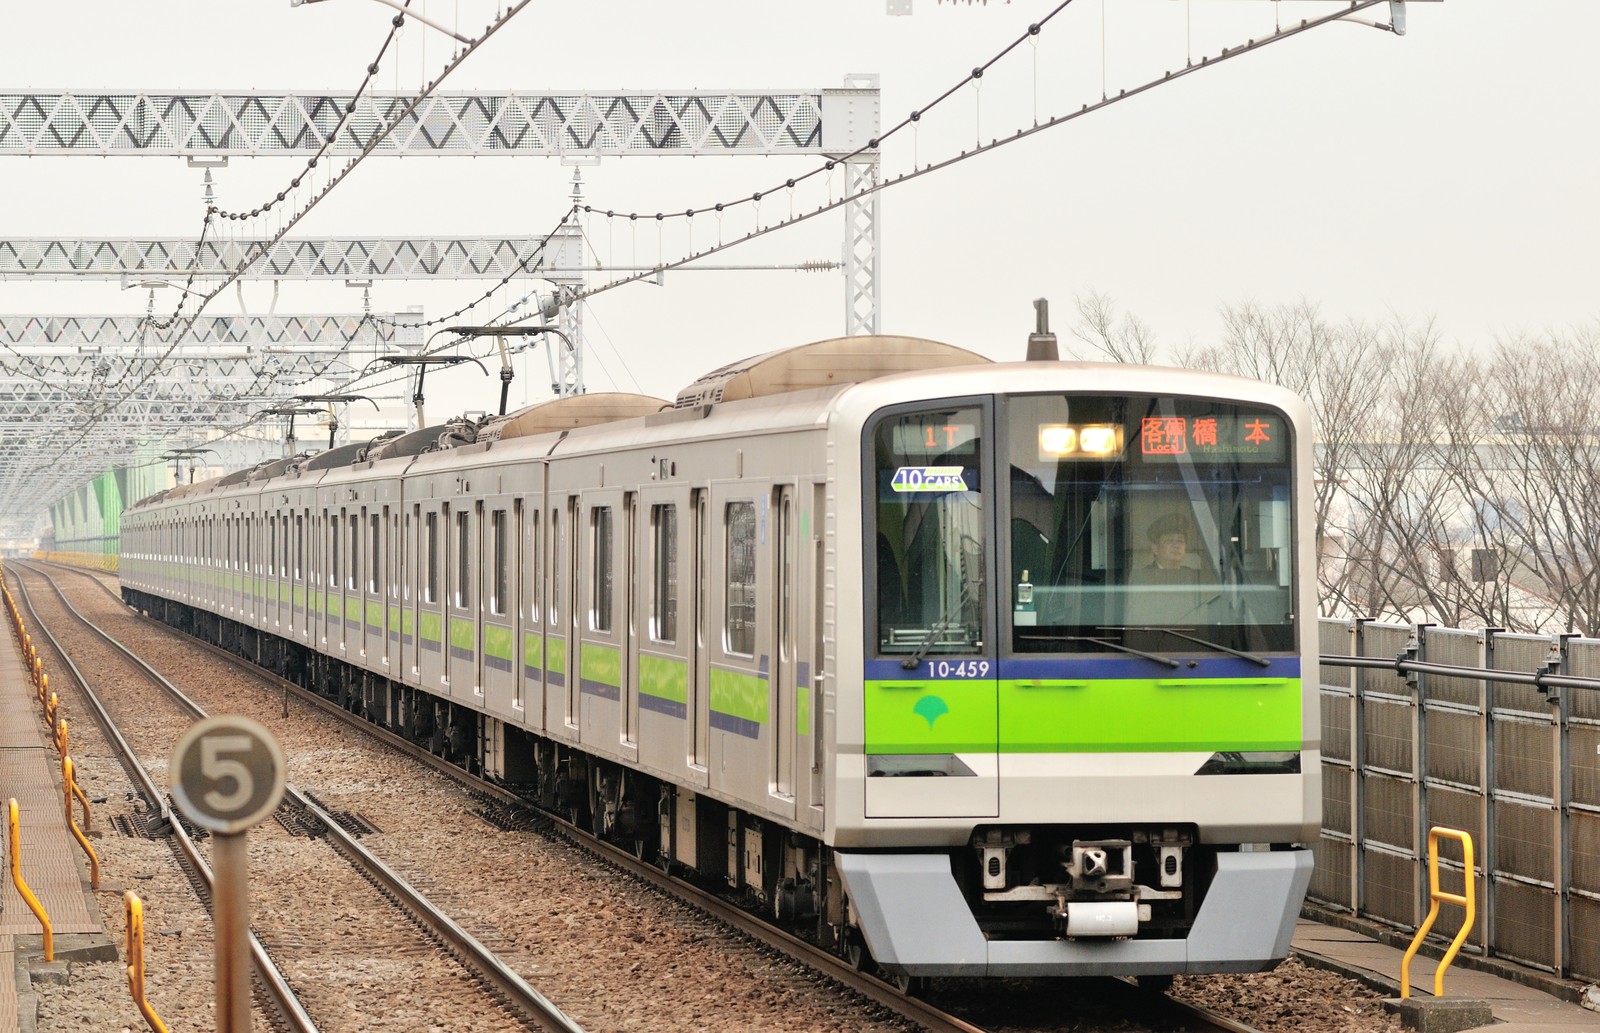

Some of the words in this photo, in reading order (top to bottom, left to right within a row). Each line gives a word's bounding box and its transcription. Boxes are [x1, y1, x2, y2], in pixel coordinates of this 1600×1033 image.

[1145, 420, 1183, 444] 各停
[1203, 445, 1259, 453] Hashimoto
[900, 469, 922, 489] 10
[925, 476, 960, 489] CARS
[928, 661, 989, 677] 10-459
[201, 735, 254, 812] 5
